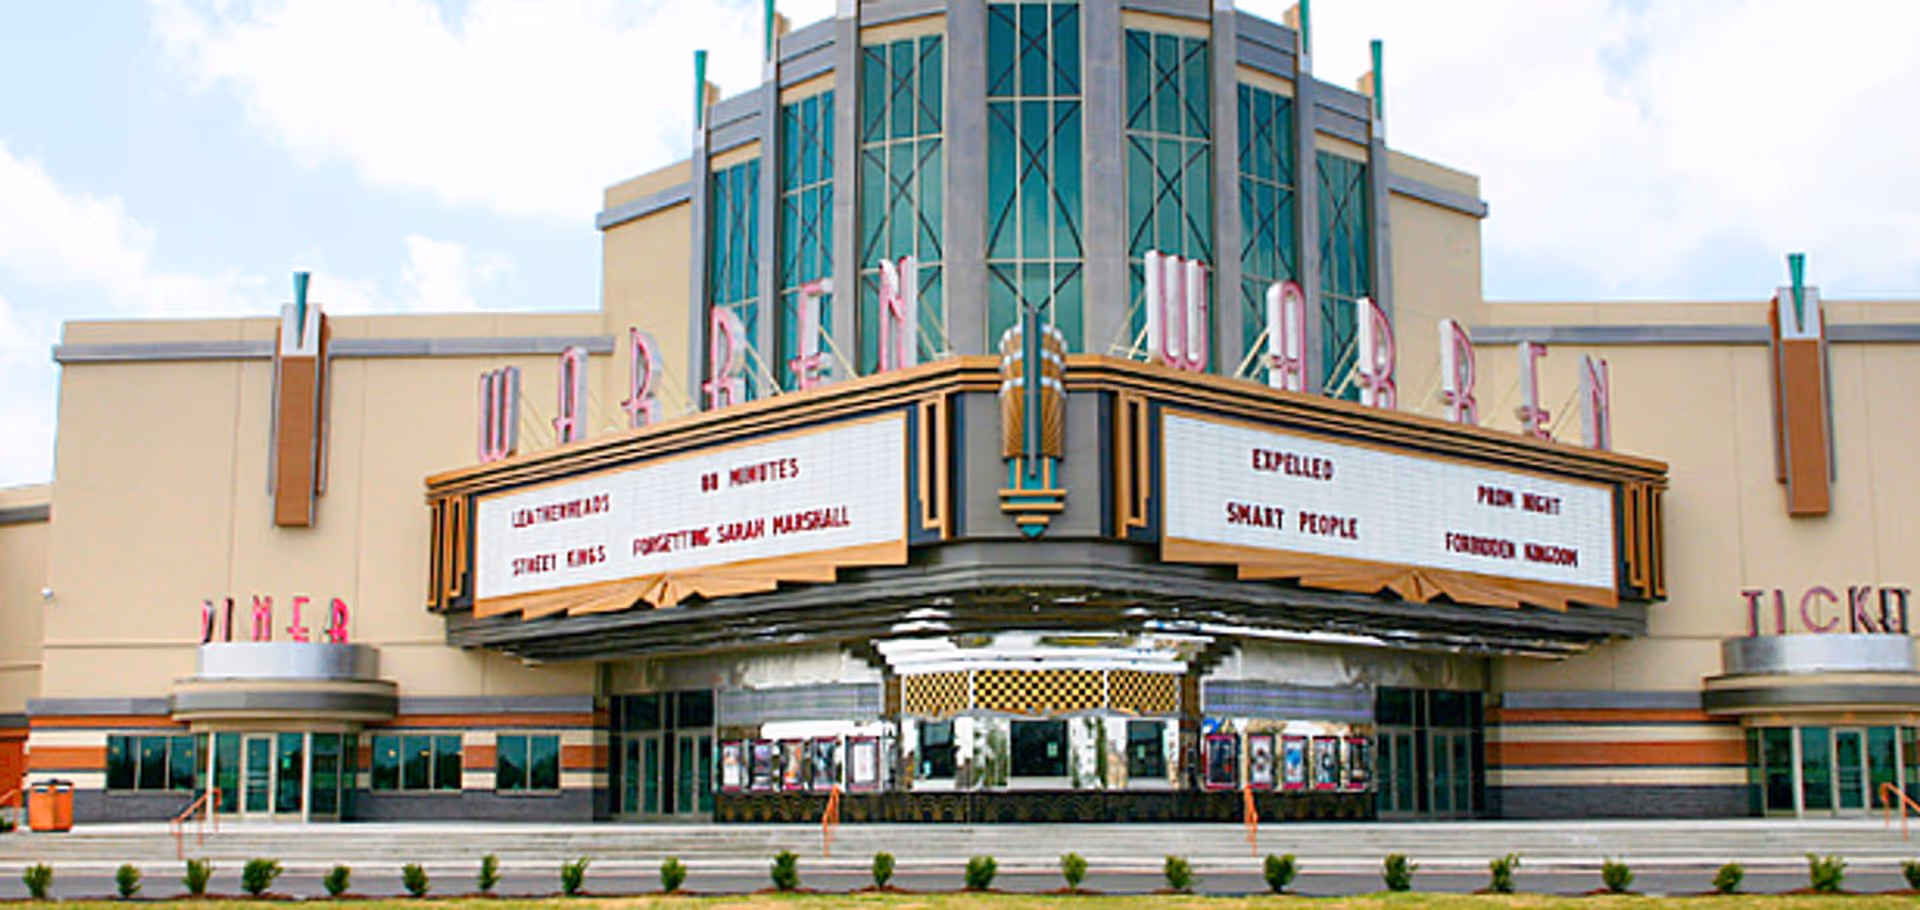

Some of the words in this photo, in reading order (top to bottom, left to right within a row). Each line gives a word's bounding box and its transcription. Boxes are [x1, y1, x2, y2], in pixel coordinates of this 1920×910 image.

[479, 256, 917, 462] WARREN
[1145, 249, 1612, 452] WARREN
[729, 457, 799, 487] MINUTES
[1252, 449, 1335, 481] EXPELLED
[511, 494, 610, 528] LEATHERHEADS
[1477, 485, 1515, 508] PROM
[1521, 492, 1562, 515] NIGHT
[632, 527, 711, 557] FORGETTING
[717, 517, 765, 543] SARAH
[773, 505, 850, 536] MARSHALL
[1227, 502, 1284, 530] SMART
[1299, 511, 1358, 540] PEOPLE
[512, 553, 557, 577] STREET
[567, 545, 606, 568] KINGS
[1445, 531, 1515, 560] FORBIDDEN
[1523, 542, 1578, 569] KINGDOM
[200, 595, 350, 644] DINER
